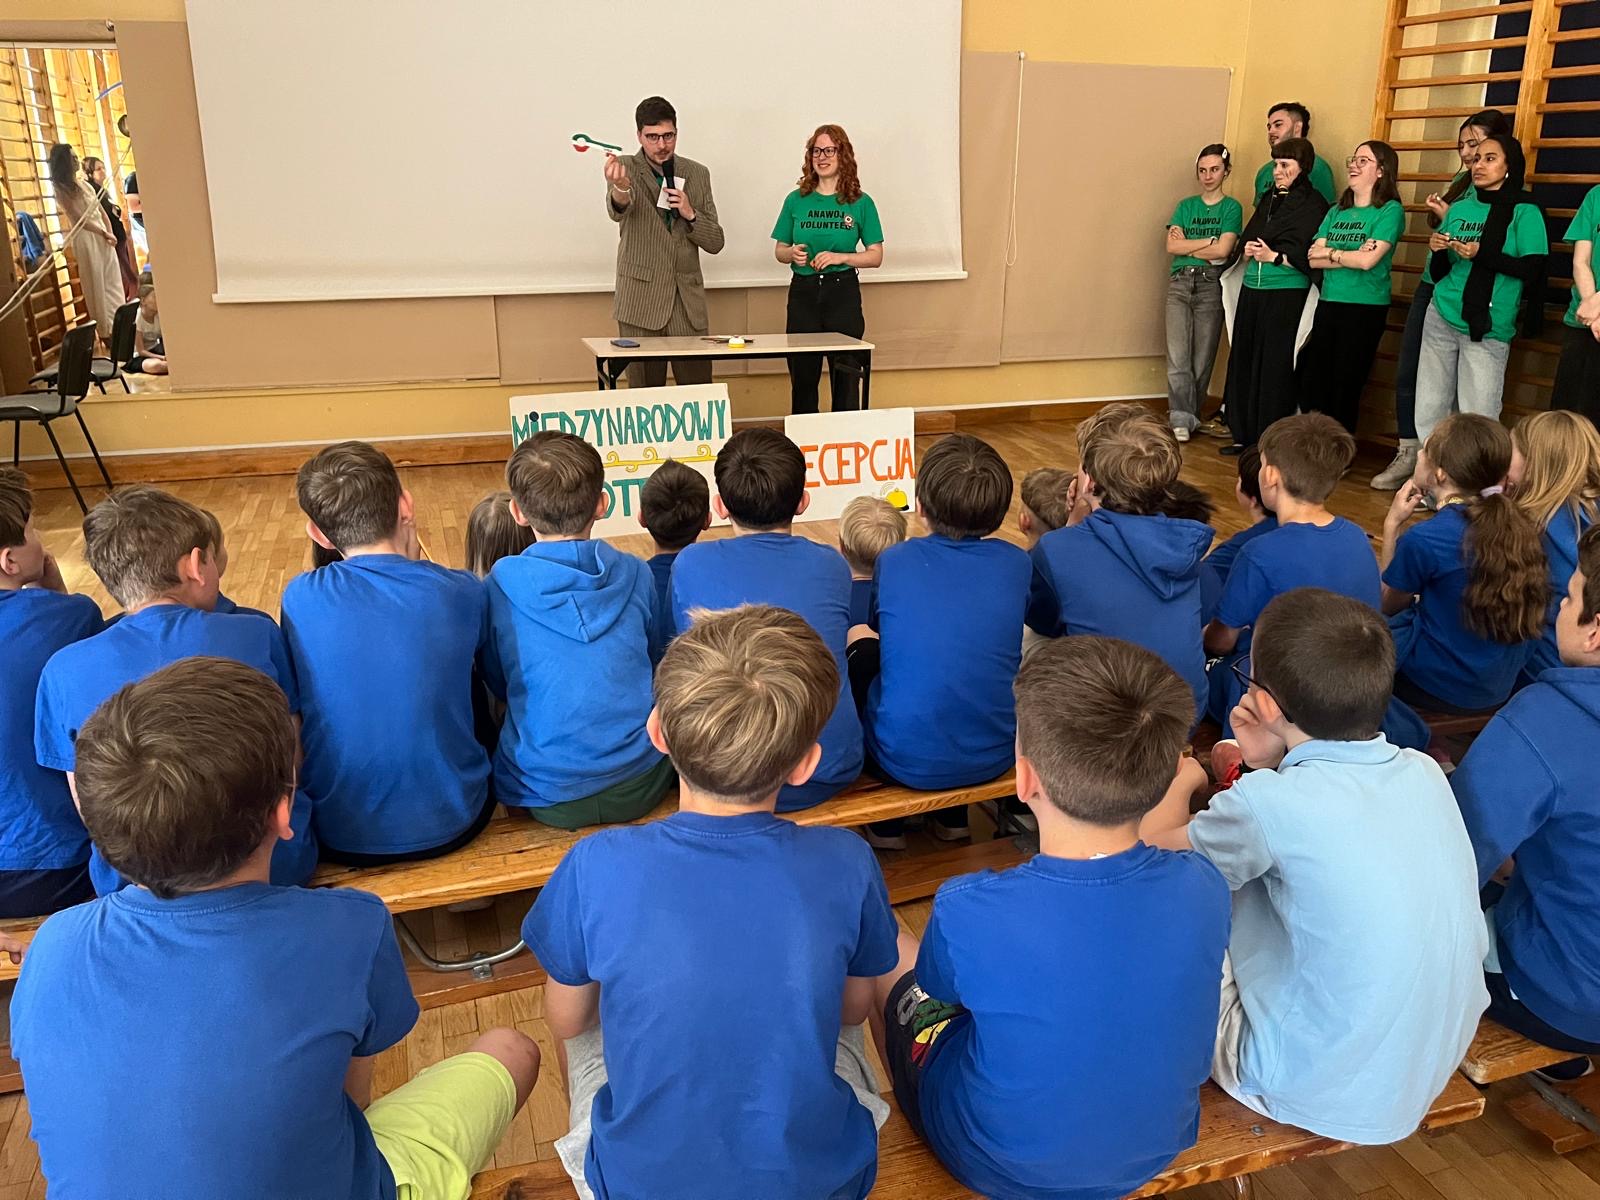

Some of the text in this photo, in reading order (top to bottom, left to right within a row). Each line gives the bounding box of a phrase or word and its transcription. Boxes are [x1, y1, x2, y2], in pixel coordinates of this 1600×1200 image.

[808, 210, 845, 218] ANAWOJ
[1332, 221, 1366, 230] ANAWOJ
[1185, 227, 1221, 236] VOLUNTEE
[1327, 232, 1366, 242] OLUNTEER
[800, 438, 916, 488] ECEPCJA
